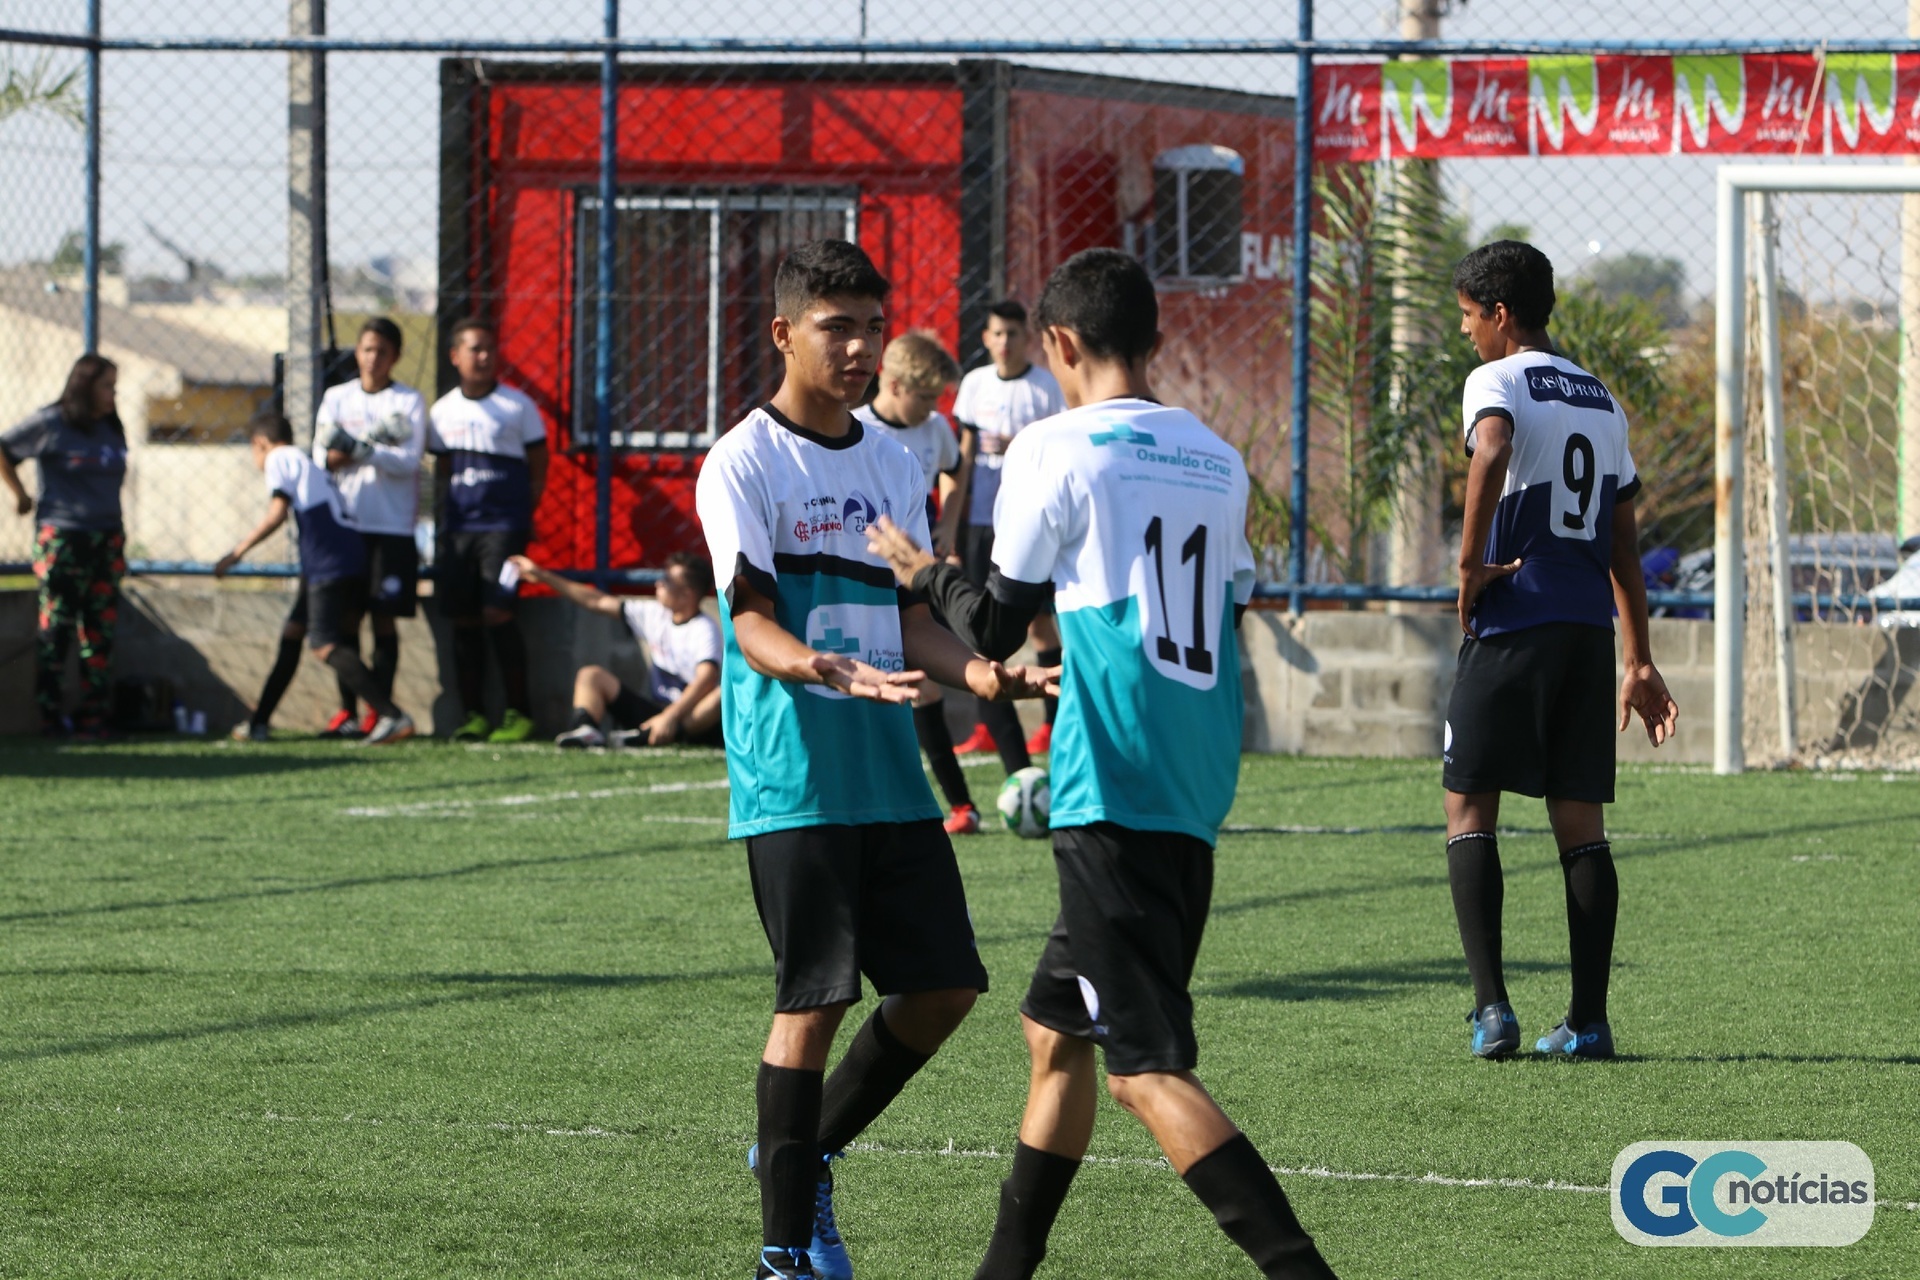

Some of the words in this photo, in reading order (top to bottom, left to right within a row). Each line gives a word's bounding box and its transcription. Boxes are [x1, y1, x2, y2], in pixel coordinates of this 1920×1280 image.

[1531, 375, 1561, 390] CASA
[1136, 446, 1200, 468] Oswaldo
[1204, 458, 1232, 478] Cruz
[1563, 432, 1595, 530] 9
[1144, 516, 1213, 675] 11
